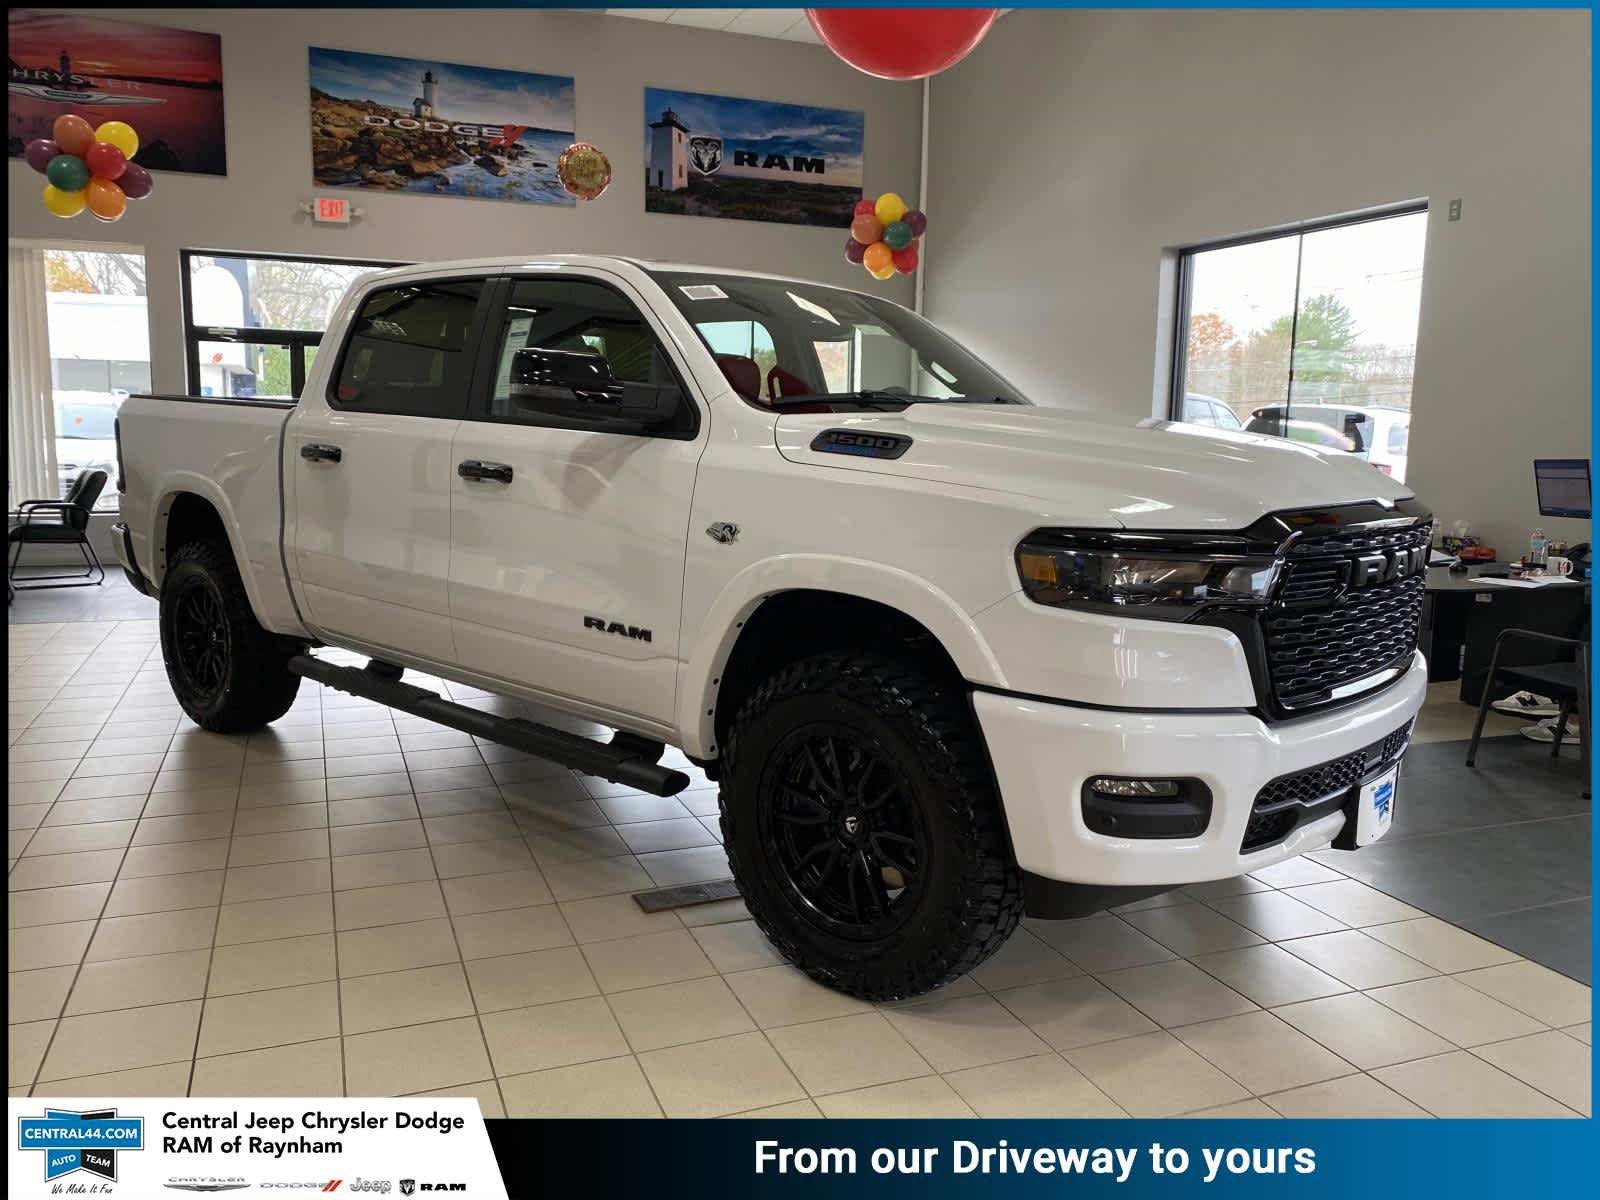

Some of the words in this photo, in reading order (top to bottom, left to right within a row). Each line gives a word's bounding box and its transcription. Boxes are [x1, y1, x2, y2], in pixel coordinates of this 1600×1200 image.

[9, 68, 142, 90] HRYSLER
[364, 115, 504, 138] DODGE
[734, 150, 825, 174] RAM
[319, 199, 345, 218] EXIT
[830, 432, 897, 449] 1500
[1357, 544, 1427, 586] RAM
[583, 615, 652, 642] RAM
